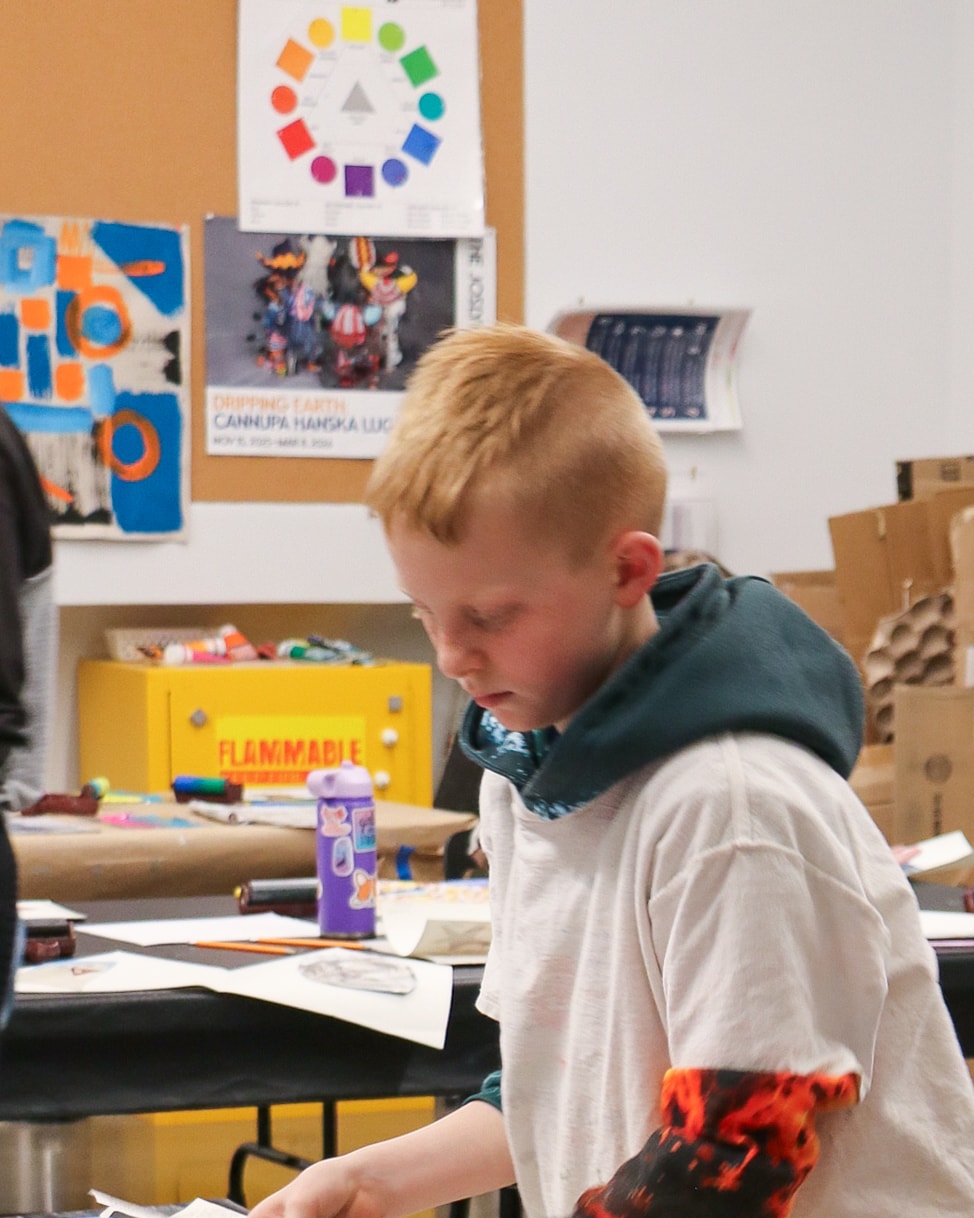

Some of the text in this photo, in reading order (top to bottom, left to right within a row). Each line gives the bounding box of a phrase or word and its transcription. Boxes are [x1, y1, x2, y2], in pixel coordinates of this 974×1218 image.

[214, 395, 346, 414] DRIPPING EARTH
[213, 412, 290, 430] CANNUPA
[293, 414, 359, 432] HANSKA
[219, 739, 362, 767] FLAMMABLE
